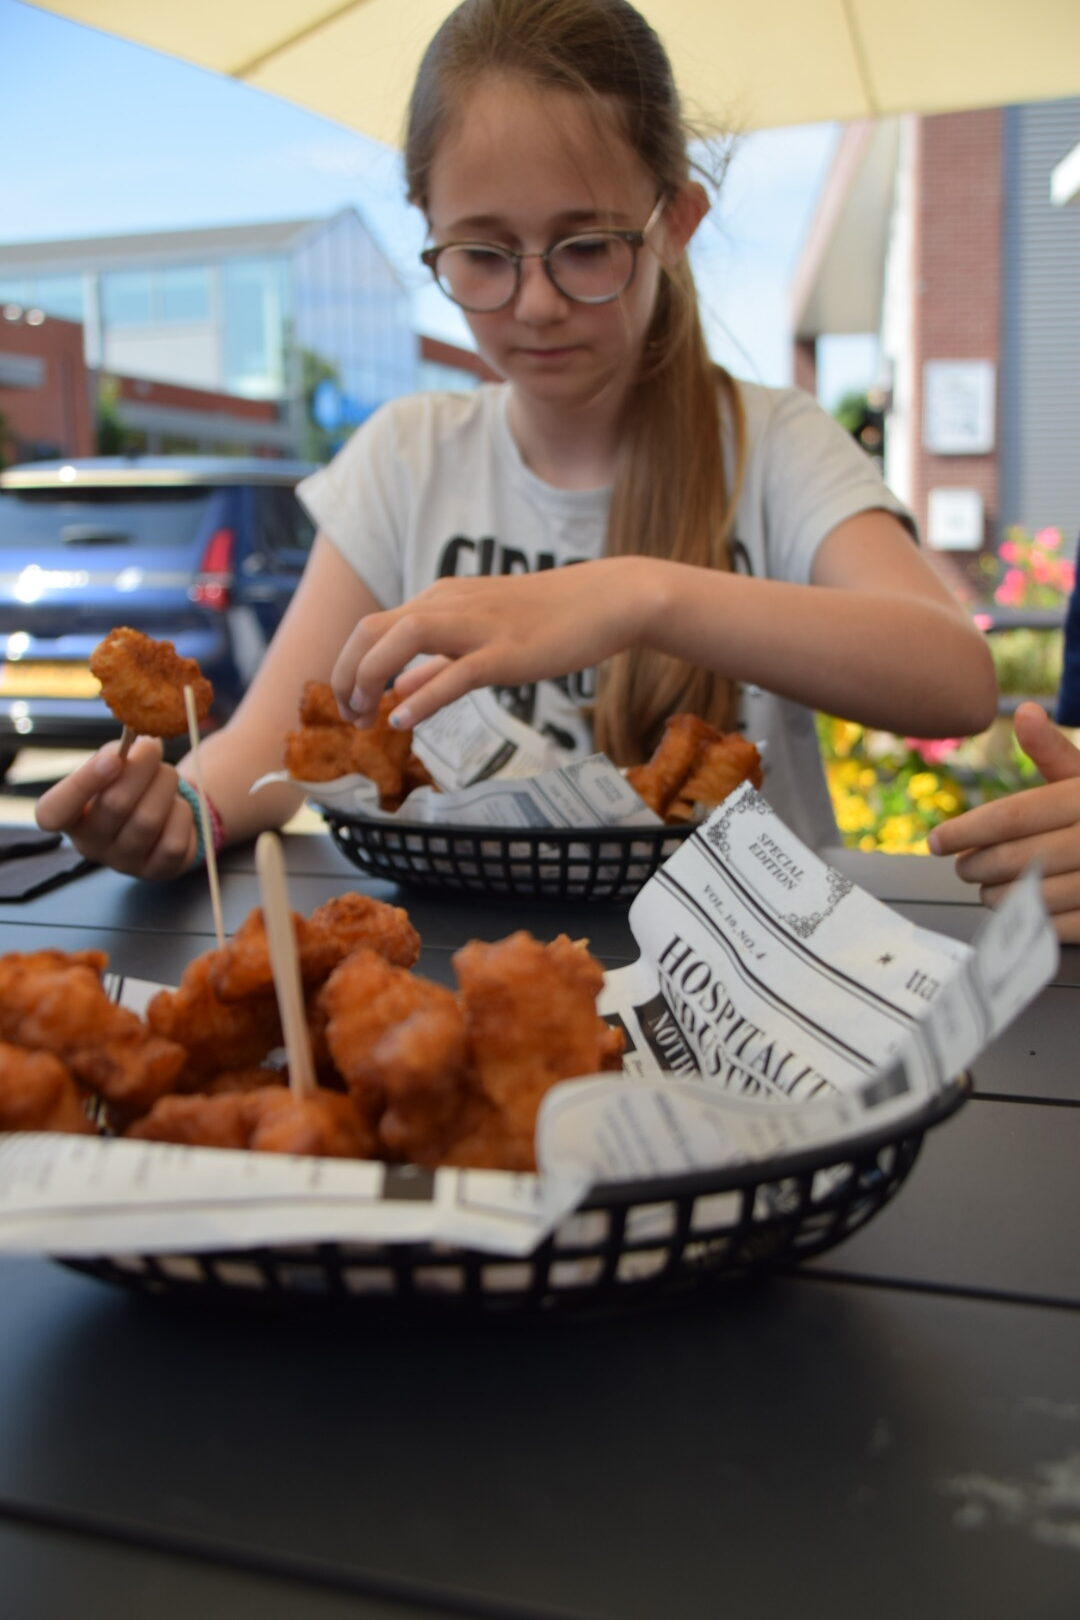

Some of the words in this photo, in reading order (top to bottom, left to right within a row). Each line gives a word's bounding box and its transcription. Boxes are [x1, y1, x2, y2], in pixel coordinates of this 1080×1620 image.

[748, 842, 798, 891] EDITION
[756, 832, 805, 882] SPECIAL
[657, 932, 843, 1100] HOSPITALIT
